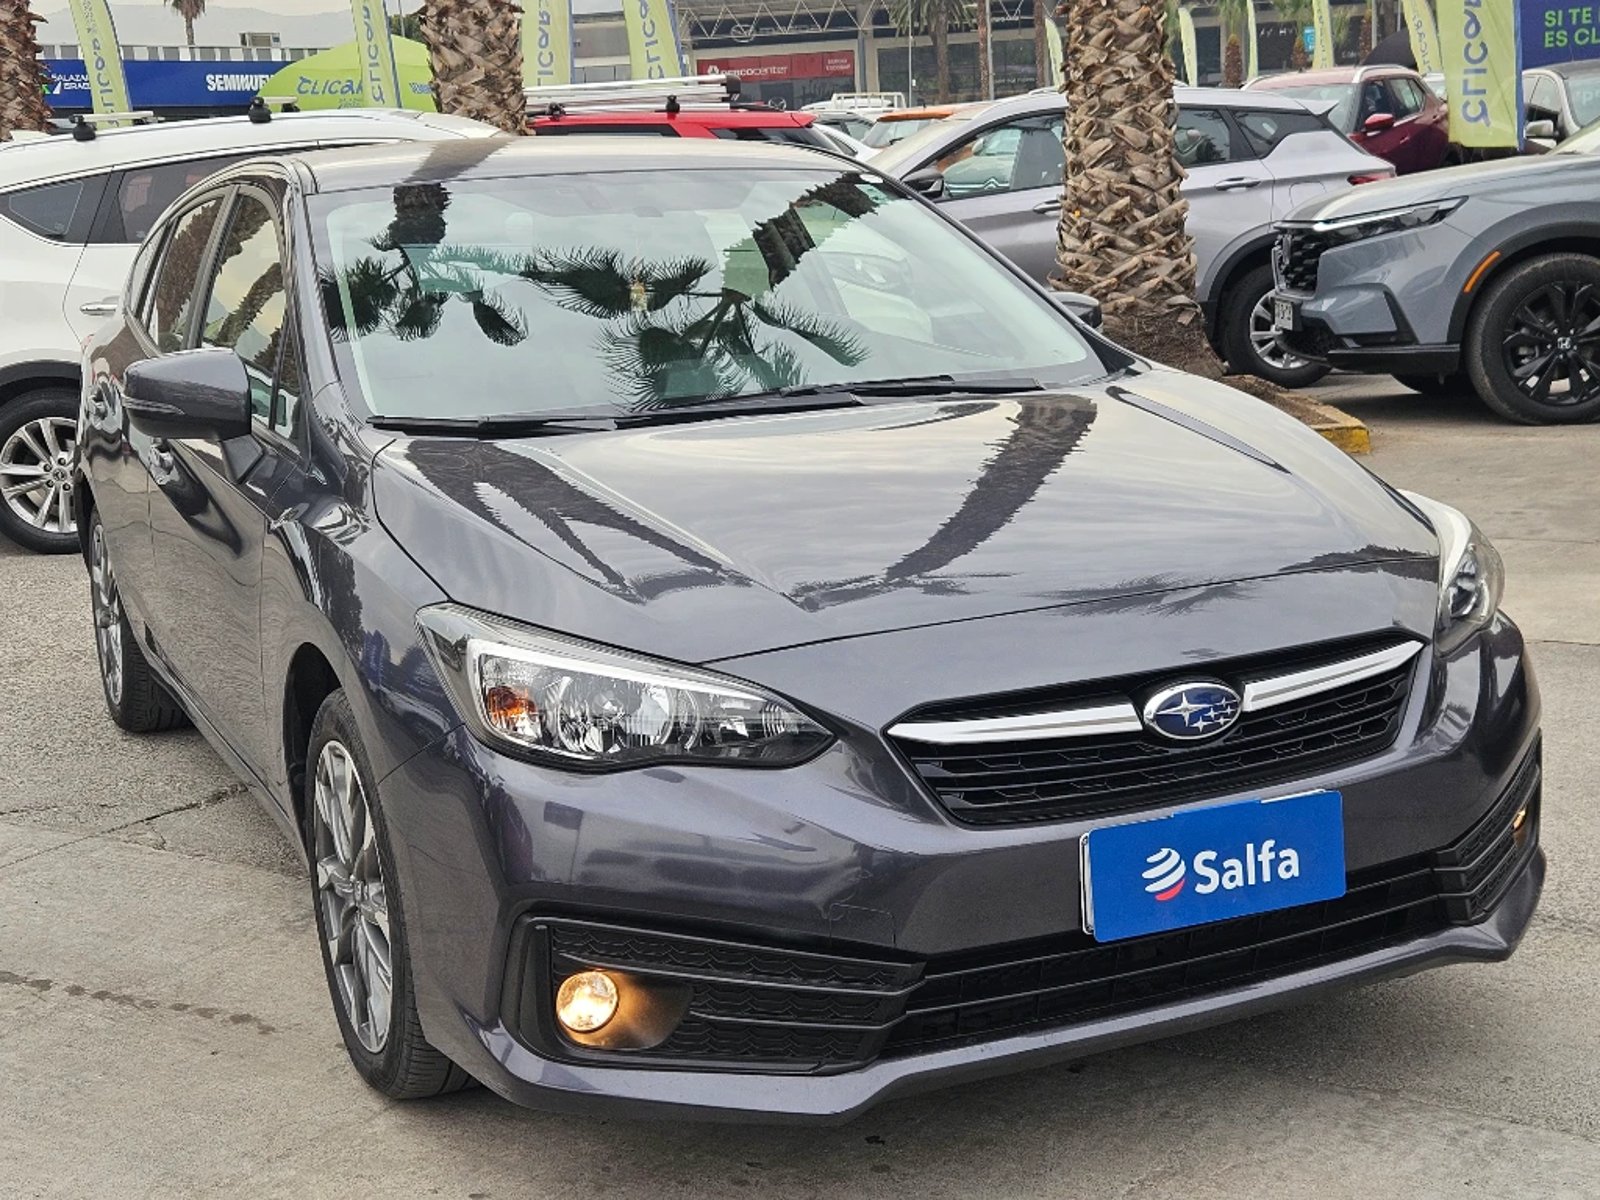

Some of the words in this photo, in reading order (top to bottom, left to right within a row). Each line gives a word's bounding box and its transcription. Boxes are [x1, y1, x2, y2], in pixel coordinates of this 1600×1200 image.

[1545, 10, 1562, 27] SI
[1568, 7, 1592, 25] TE
[1545, 30, 1568, 47] ES
[1193, 839, 1300, 895] Salfa
